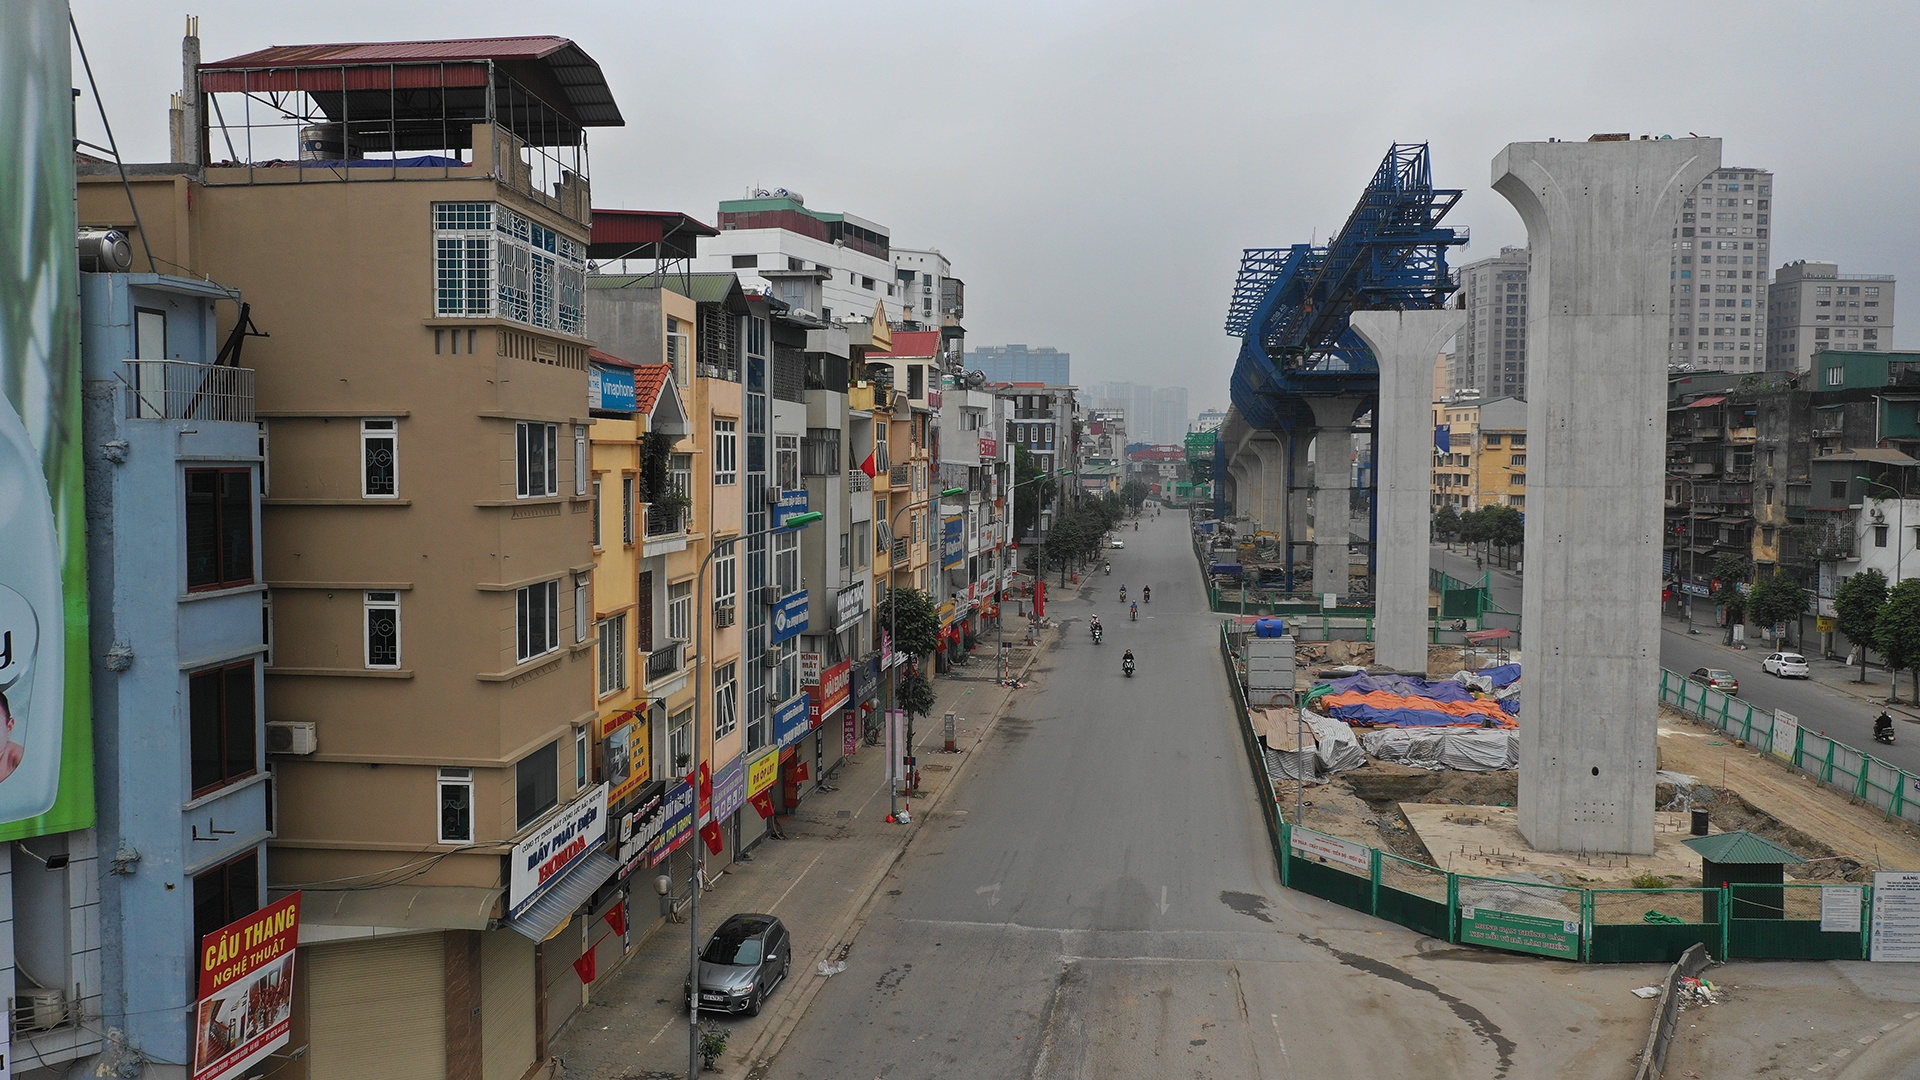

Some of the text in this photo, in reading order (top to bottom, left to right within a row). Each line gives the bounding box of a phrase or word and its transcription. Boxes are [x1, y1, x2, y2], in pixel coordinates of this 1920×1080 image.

[603, 377, 634, 398] vinaphone
[527, 806, 598, 872] MÁY PHÁT ĐIỆN
[538, 835, 587, 886] HONDA
[205, 904, 296, 971] CẦU THANG
[1475, 923, 1566, 942] MONG BẠN THÔNG CẢM
[1485, 932, 1499, 940] LỖI
[1524, 939, 1541, 948] LÀM
[213, 937, 286, 988] NGHỆ THUẬT
